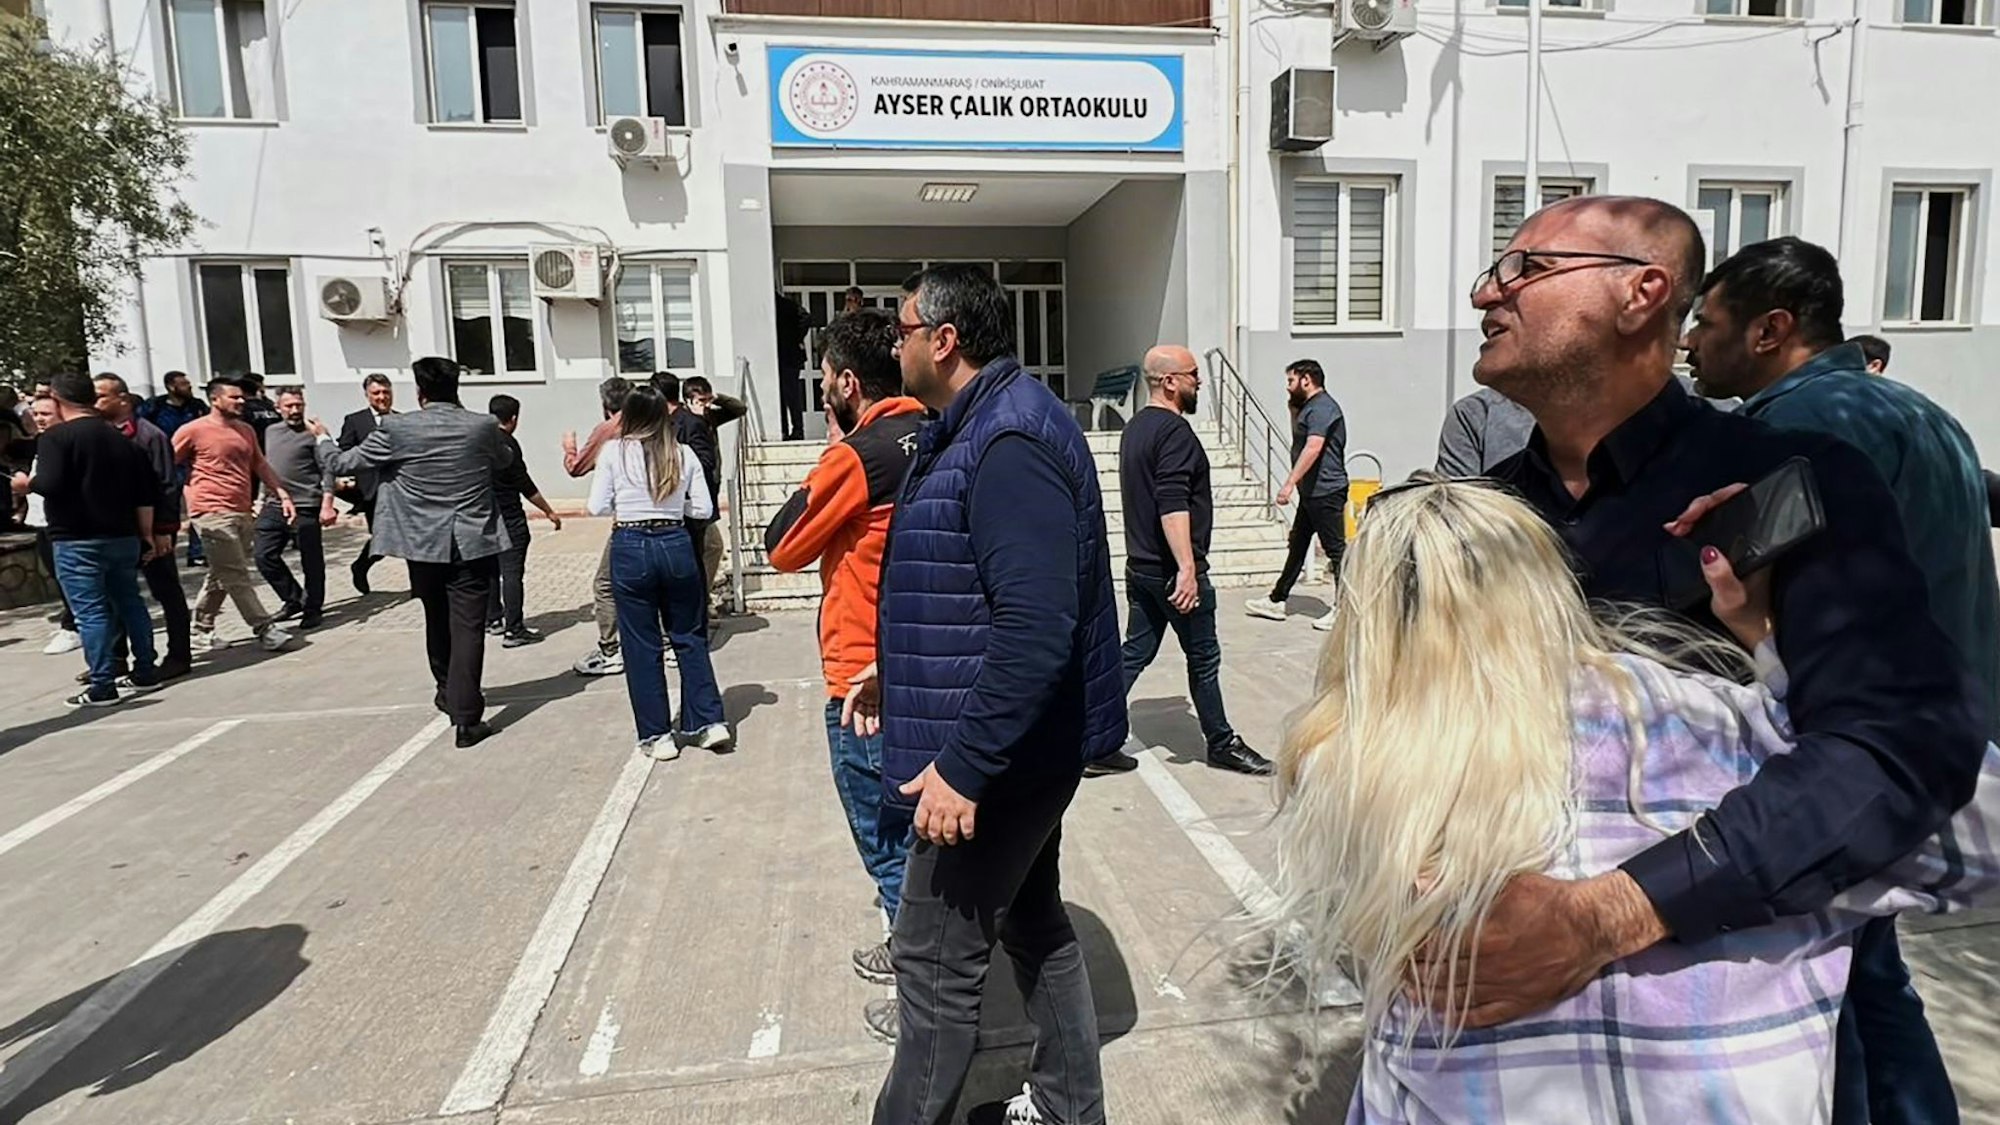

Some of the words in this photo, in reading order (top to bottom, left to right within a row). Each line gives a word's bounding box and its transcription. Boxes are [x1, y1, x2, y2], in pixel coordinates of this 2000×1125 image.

[871, 76, 972, 90] KAHRAMANMARAŞ
[980, 77, 1045, 91] ONİKİŞUBAT
[874, 94, 944, 116] AYSER
[950, 95, 1014, 120] ÇALIK
[1019, 96, 1148, 118] ORTAOKULU
